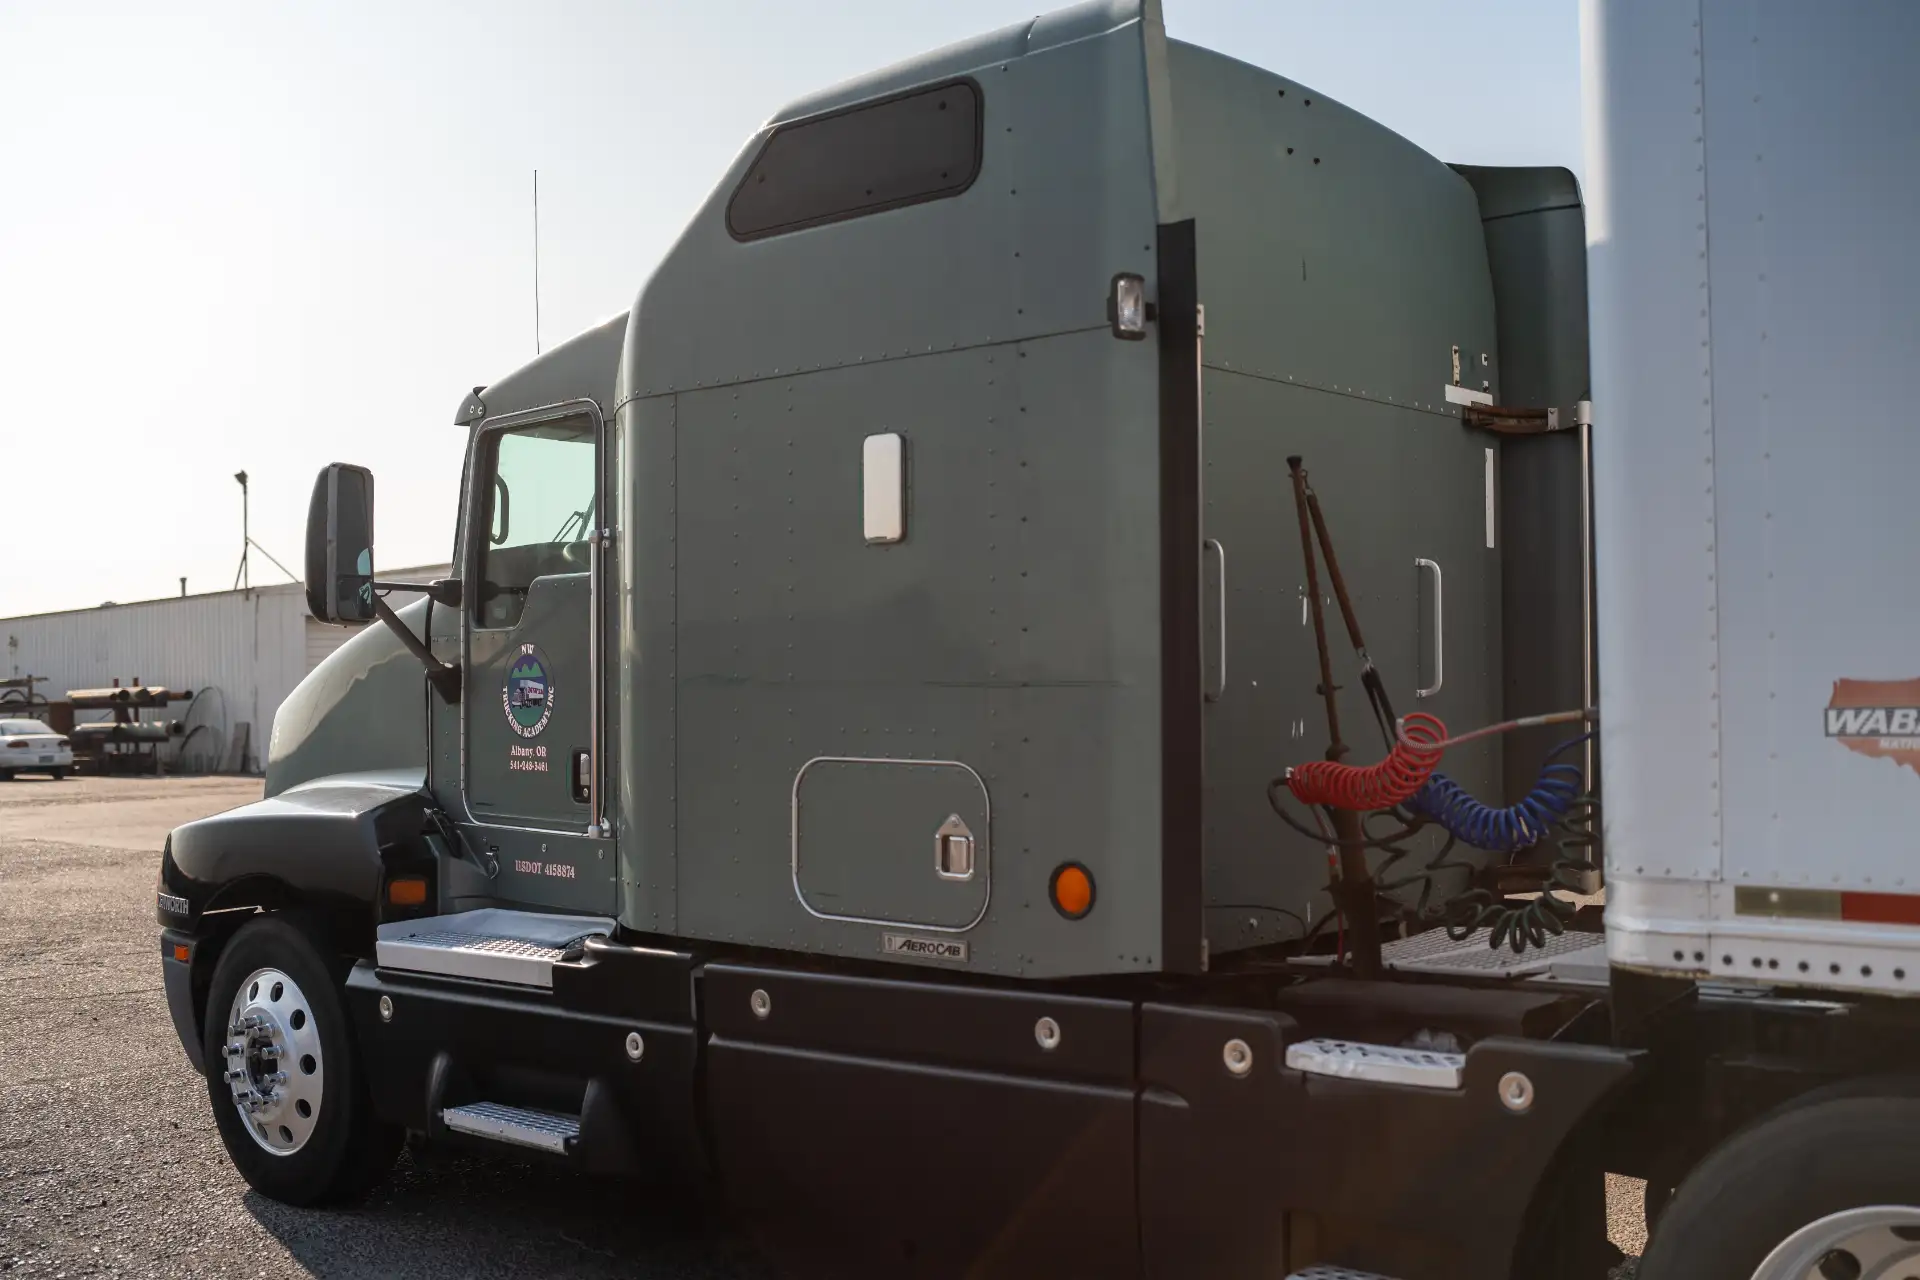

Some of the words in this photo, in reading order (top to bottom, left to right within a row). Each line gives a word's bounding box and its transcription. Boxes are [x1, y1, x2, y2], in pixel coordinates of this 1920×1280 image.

[521, 643, 535, 655] NW
[502, 685, 522, 735] TRUCKING
[1827, 708, 1920, 735] WAB
[536, 745, 547, 757] OR
[515, 859, 542, 875] USDOT
[544, 863, 575, 879] 4158874
[898, 939, 961, 957] AEROCAB
